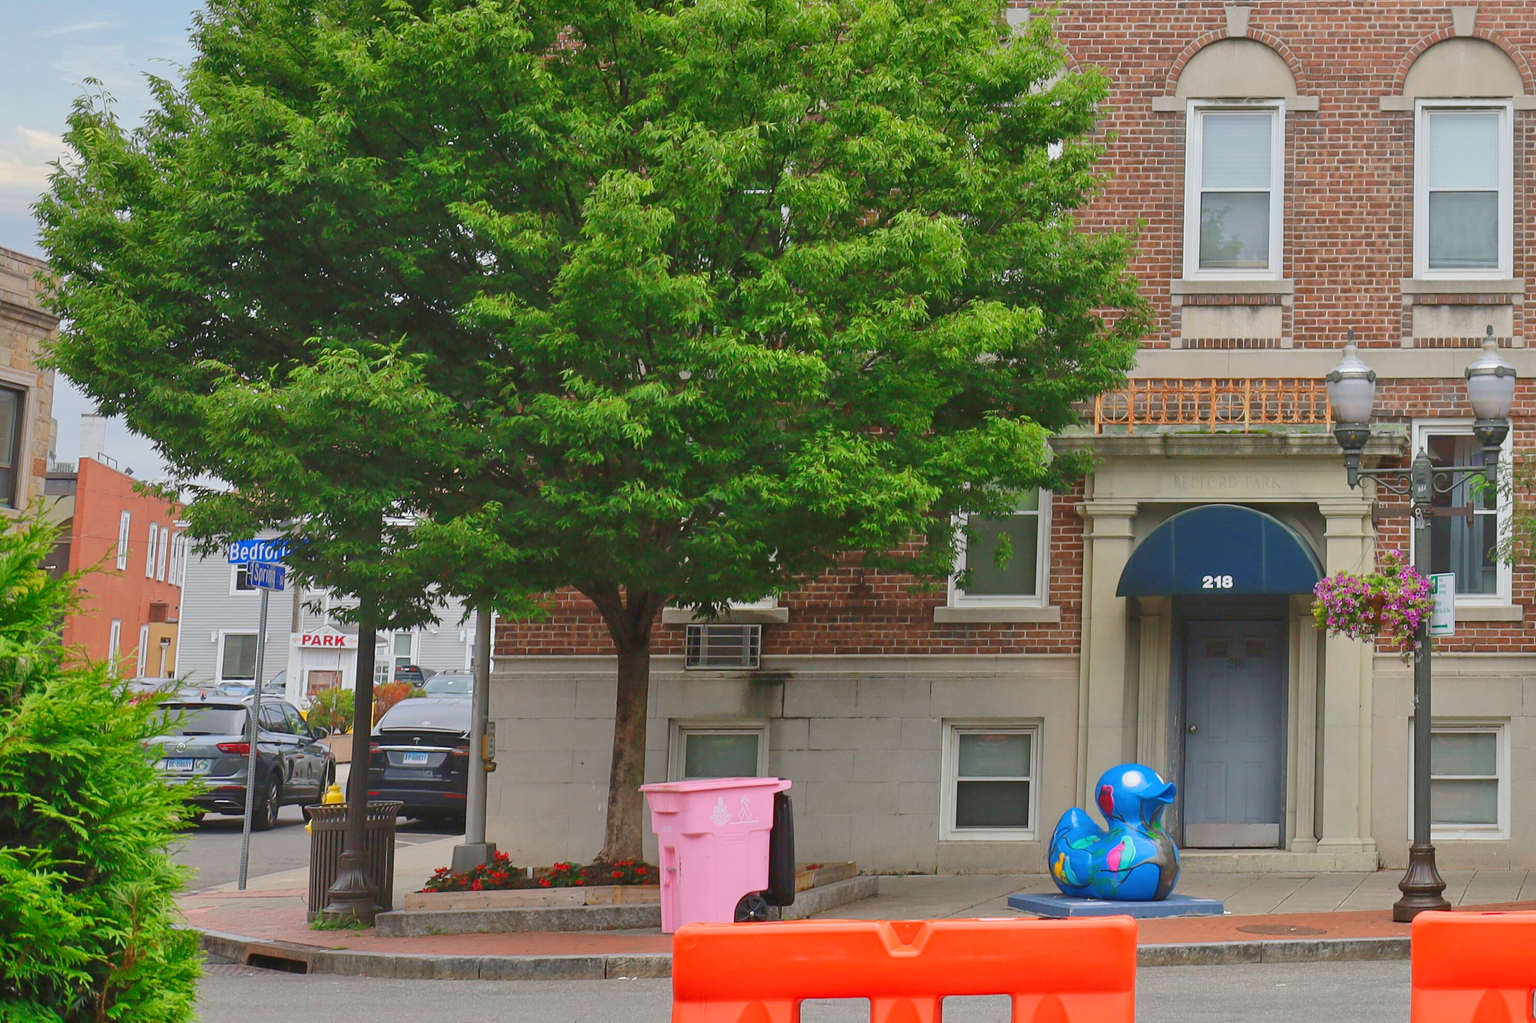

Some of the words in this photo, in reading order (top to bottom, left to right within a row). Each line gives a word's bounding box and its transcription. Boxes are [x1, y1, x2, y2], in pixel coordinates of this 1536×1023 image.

[1173, 476, 1237, 489] BEDFORD
[1246, 476, 1282, 489] PARK
[253, 562, 276, 589] Spring
[1202, 575, 1234, 589] 218
[302, 634, 347, 647] PARK
[1226, 658, 1246, 670] 218
